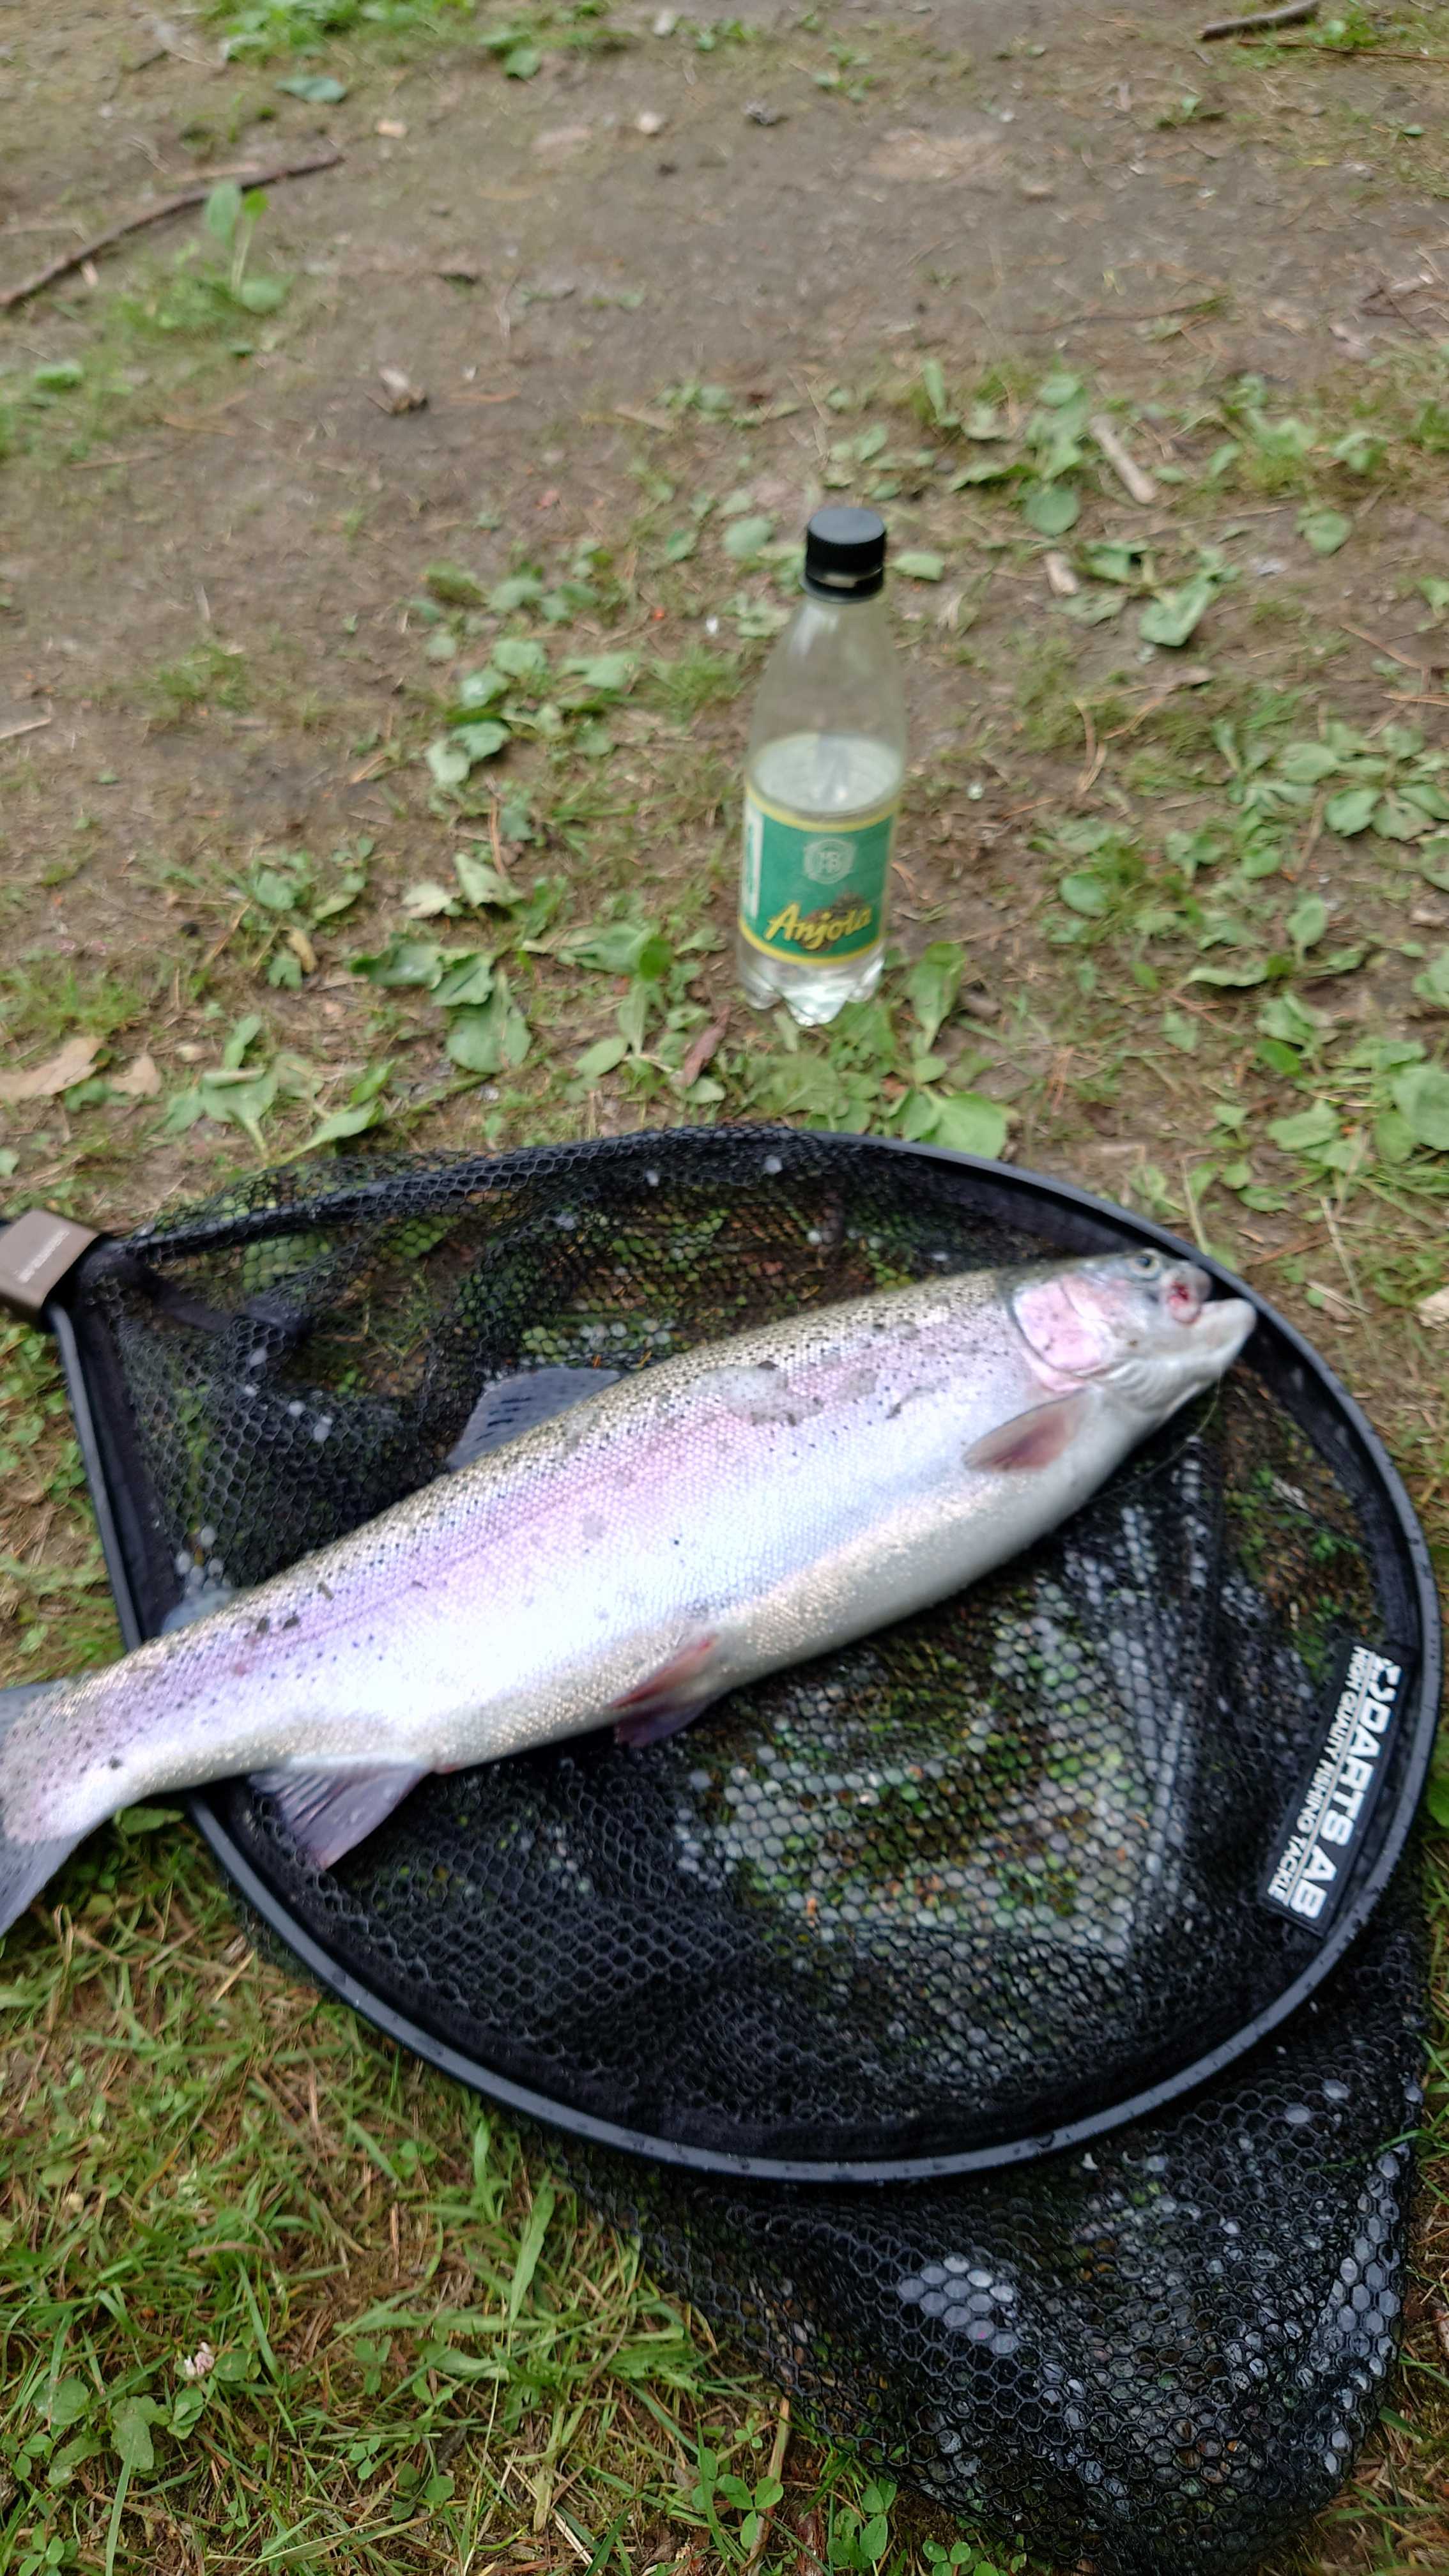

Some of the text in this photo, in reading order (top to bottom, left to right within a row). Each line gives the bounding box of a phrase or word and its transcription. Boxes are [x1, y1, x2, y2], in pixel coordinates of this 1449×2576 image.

[1267, 1645, 1371, 1905] HIGH QUALITY FISHING TACKLE
[1289, 1698, 1392, 1919] DARTS AB
